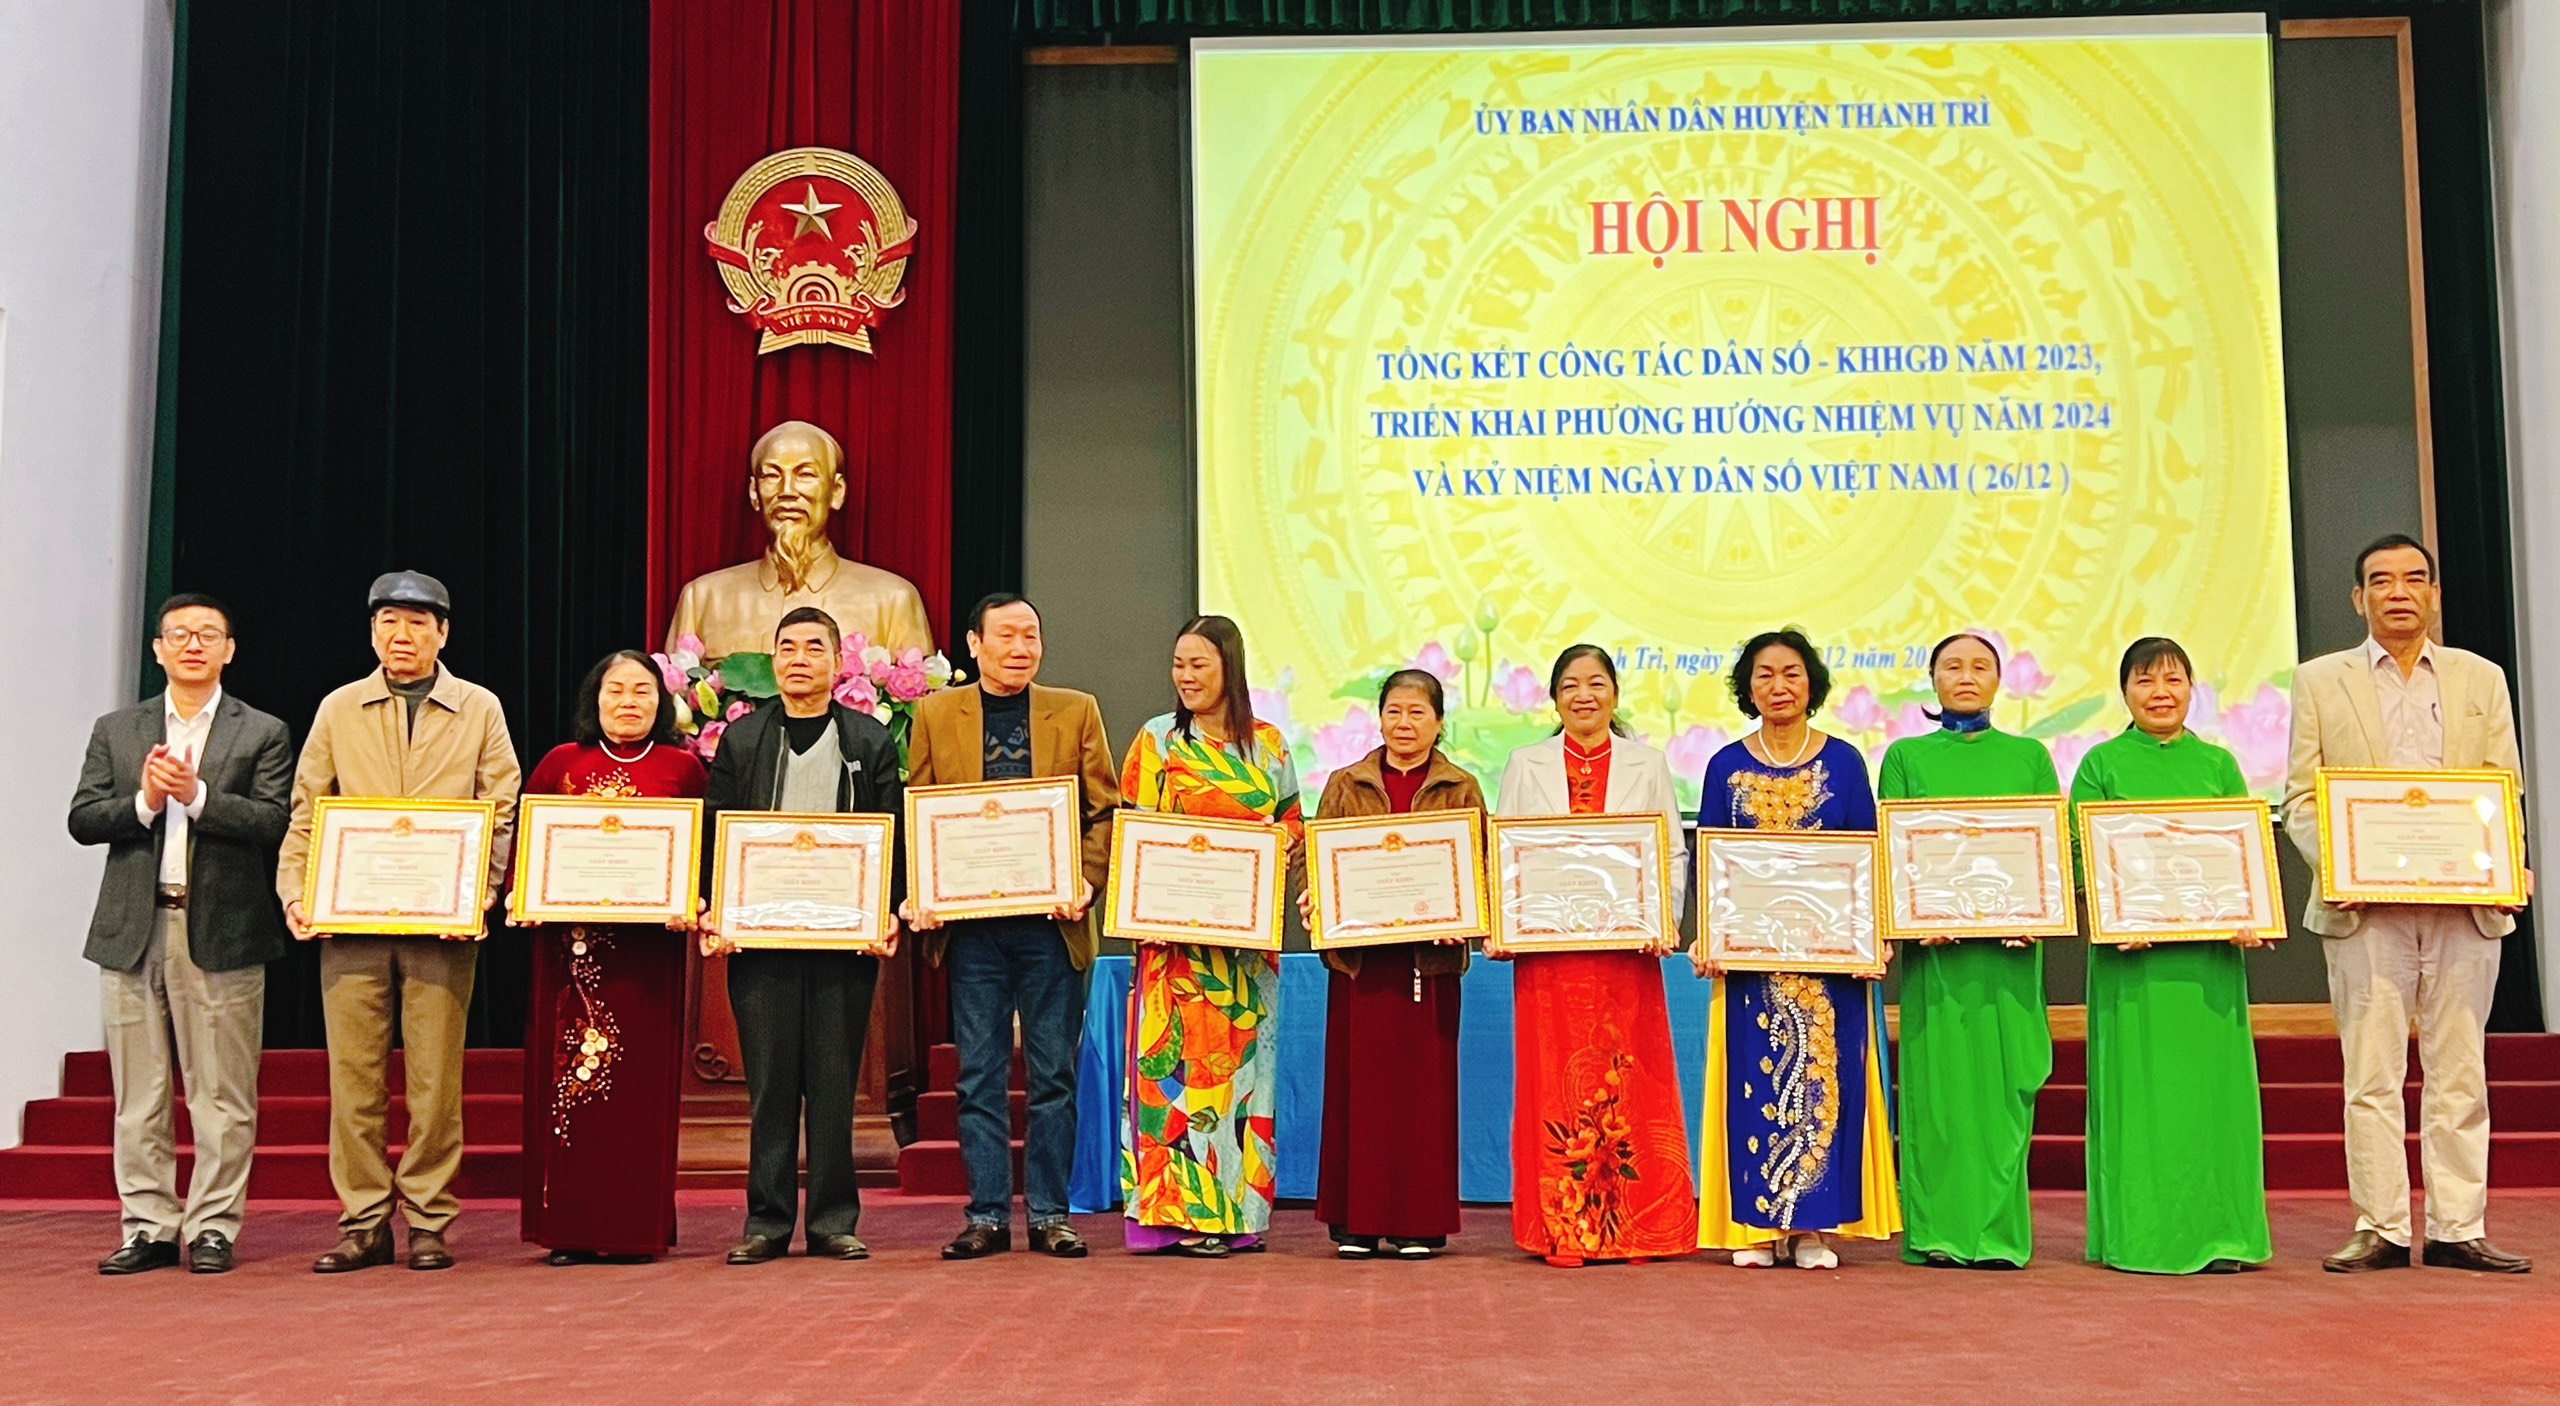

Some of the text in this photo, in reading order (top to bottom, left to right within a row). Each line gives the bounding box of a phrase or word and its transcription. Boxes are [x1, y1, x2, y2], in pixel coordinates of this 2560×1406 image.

[1475, 95, 1991, 136] ỦY BAN NHÂN DÂN HUYỆN THANH TRÌ
[1588, 191, 1882, 269] HỘI NGHỊ
[819, 313, 849, 329] NAM
[1376, 345, 1462, 380] TỔNG
[1470, 344, 1530, 379] KẾT
[1539, 341, 1625, 378] CÔNG
[1632, 341, 1693, 377] TÁC
[1702, 339, 1763, 376] DÂN
[1772, 340, 1810, 375] SỐ
[1836, 345, 1948, 373] KHHGĐ
[1956, 338, 2027, 372] NĂM
[2035, 344, 2102, 376] 2023,
[1470, 409, 1547, 436] KHAI
[1555, 403, 1685, 436] PHƯƠNG
[1692, 398, 1805, 434] HƯỚNG
[1812, 400, 1915, 438] NHIỆM
[1923, 402, 1965, 438] VỤ
[1973, 396, 2044, 431] NĂM
[2051, 402, 2112, 430] 2024
[1413, 461, 1455, 496] VÀ
[1463, 460, 1505, 496] KỶ
[1513, 464, 1592, 502] NIỆM
[1601, 458, 1685, 494] NGÀY
[1692, 456, 1755, 493] DÂN
[1763, 457, 1802, 492] SỐ
[1809, 459, 1881, 498] VIỆT
[1889, 463, 1959, 491] NAM
[1984, 462, 2052, 490] 26/12
[1676, 647, 1724, 676] ngày
[1852, 647, 1896, 668] năm
